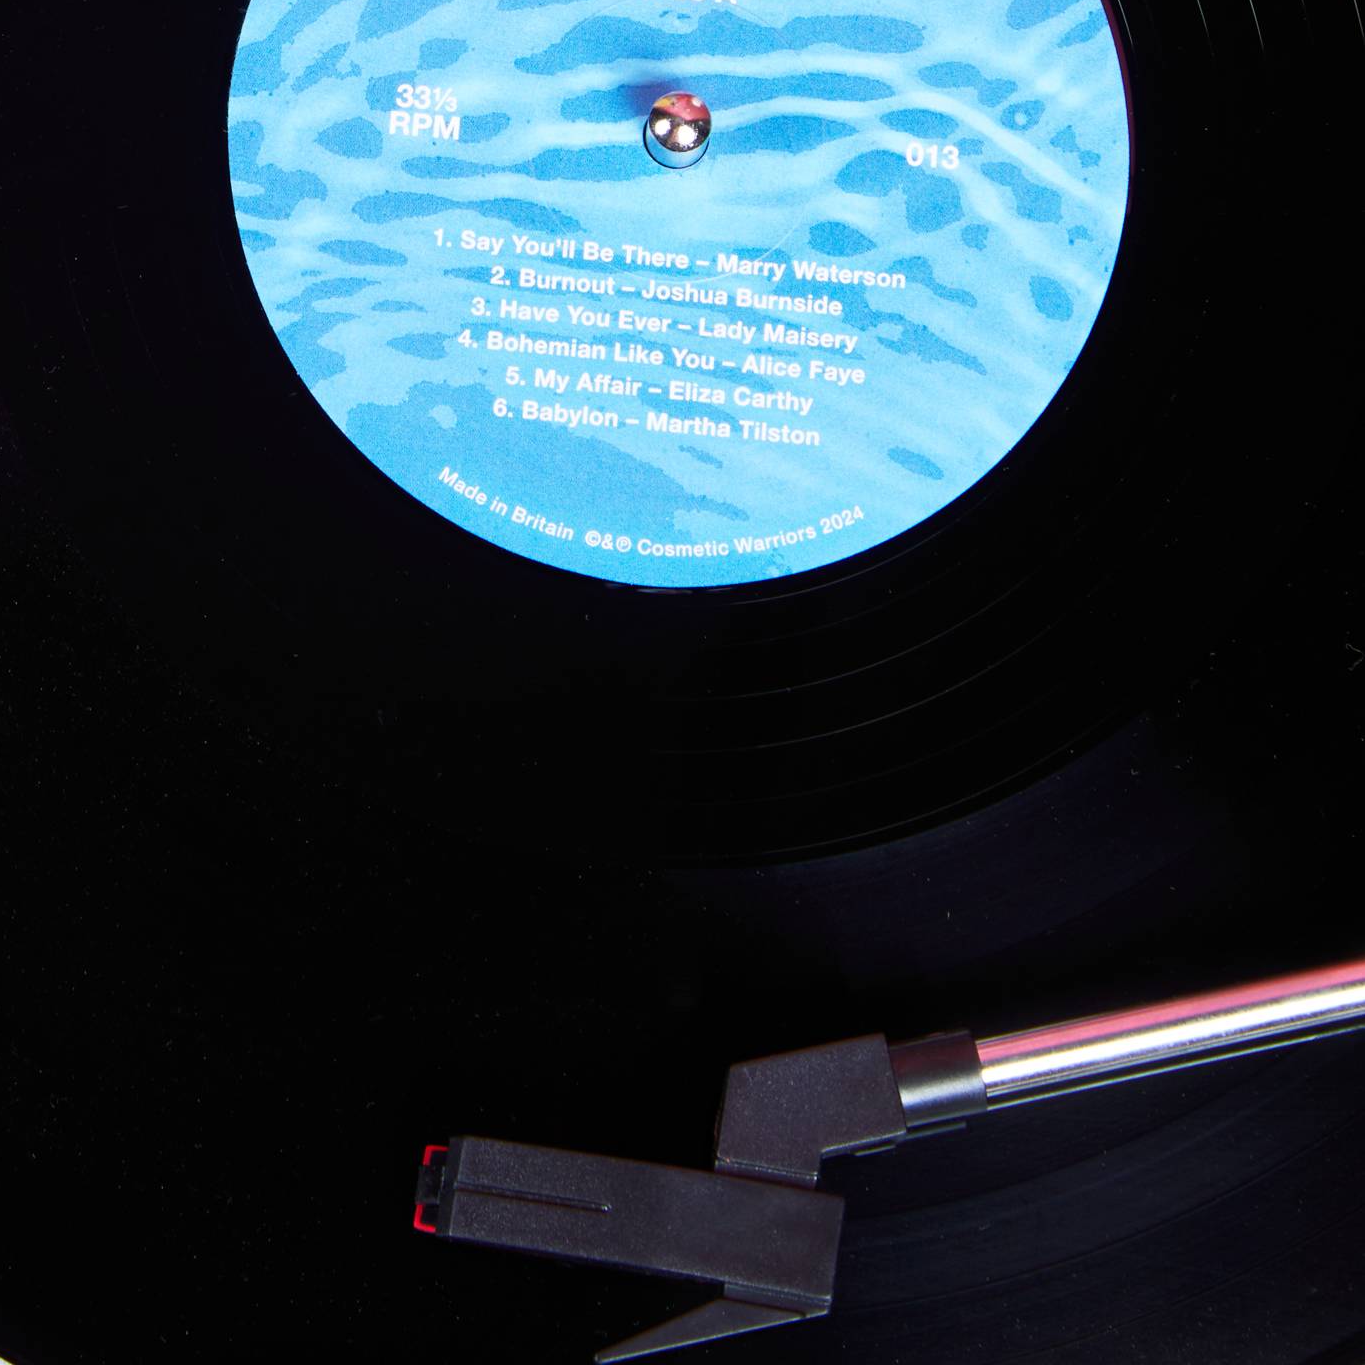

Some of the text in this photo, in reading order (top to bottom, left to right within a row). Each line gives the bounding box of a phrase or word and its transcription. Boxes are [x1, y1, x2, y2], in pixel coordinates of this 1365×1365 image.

[388, 110, 461, 140] RPM
[905, 142, 960, 172] 013
[434, 229, 452, 248] 1.
[460, 230, 504, 255] Say
[512, 234, 576, 259] You'll
[583, 240, 614, 262] Be
[621, 244, 689, 269] There
[716, 253, 786, 282] Marry
[793, 261, 907, 289] Waterson
[490, 266, 511, 287] 2.
[519, 269, 616, 295] Burnout
[642, 279, 729, 306] Joshua
[735, 288, 843, 315] Burnside
[471, 297, 491, 317] 3.
[500, 299, 560, 323] Have
[567, 305, 611, 327] You
[617, 310, 671, 332] Ever
[698, 319, 756, 344] Lady
[763, 324, 859, 354] Maisery
[457, 329, 478, 348] 4.
[486, 331, 606, 361] Bohemian
[613, 342, 664, 365] Like
[671, 348, 715, 370] You
[742, 354, 802, 378] Alice
[809, 360, 867, 387] Faye
[506, 366, 526, 386] 5.
[534, 369, 570, 393] My
[577, 373, 642, 396] Affair
[668, 380, 726, 405] Eliza
[734, 386, 814, 417] Carthy
[492, 398, 513, 418] 6.
[522, 400, 619, 428] Babylon
[646, 411, 732, 438] Martha
[738, 420, 821, 447] Tilston
[438, 465, 488, 506] Made
[489, 496, 509, 517] in
[510, 505, 575, 541] Britain
[636, 538, 729, 557] Cosmetic
[733, 525, 816, 555] Warriors
[819, 505, 865, 535] 2024
